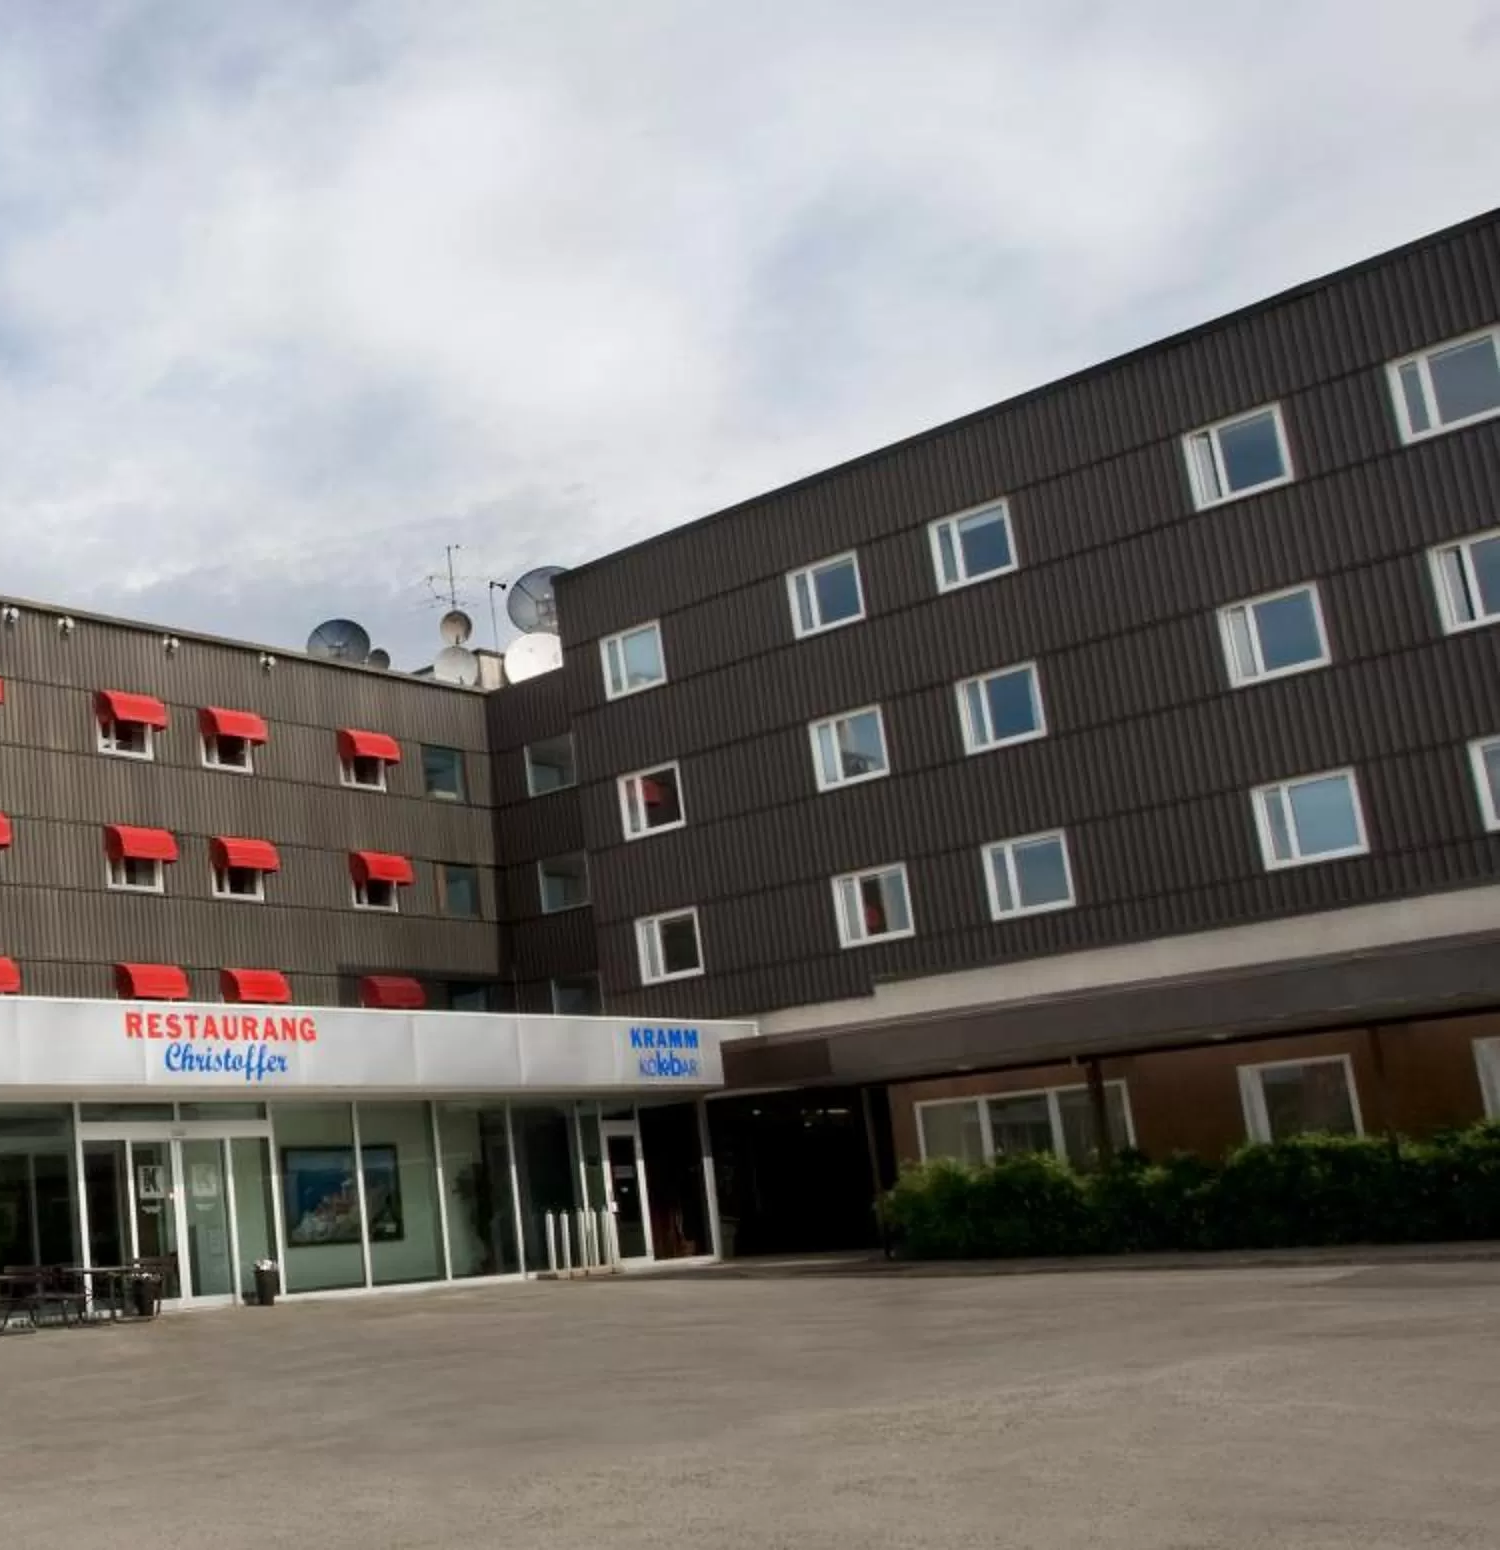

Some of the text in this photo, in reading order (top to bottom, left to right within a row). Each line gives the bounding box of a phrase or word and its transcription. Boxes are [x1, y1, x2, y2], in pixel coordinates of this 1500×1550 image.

[124, 1012, 317, 1043] RESTAURANG
[630, 1027, 699, 1049] KRAMM
[164, 1041, 288, 1080] Christoffer
